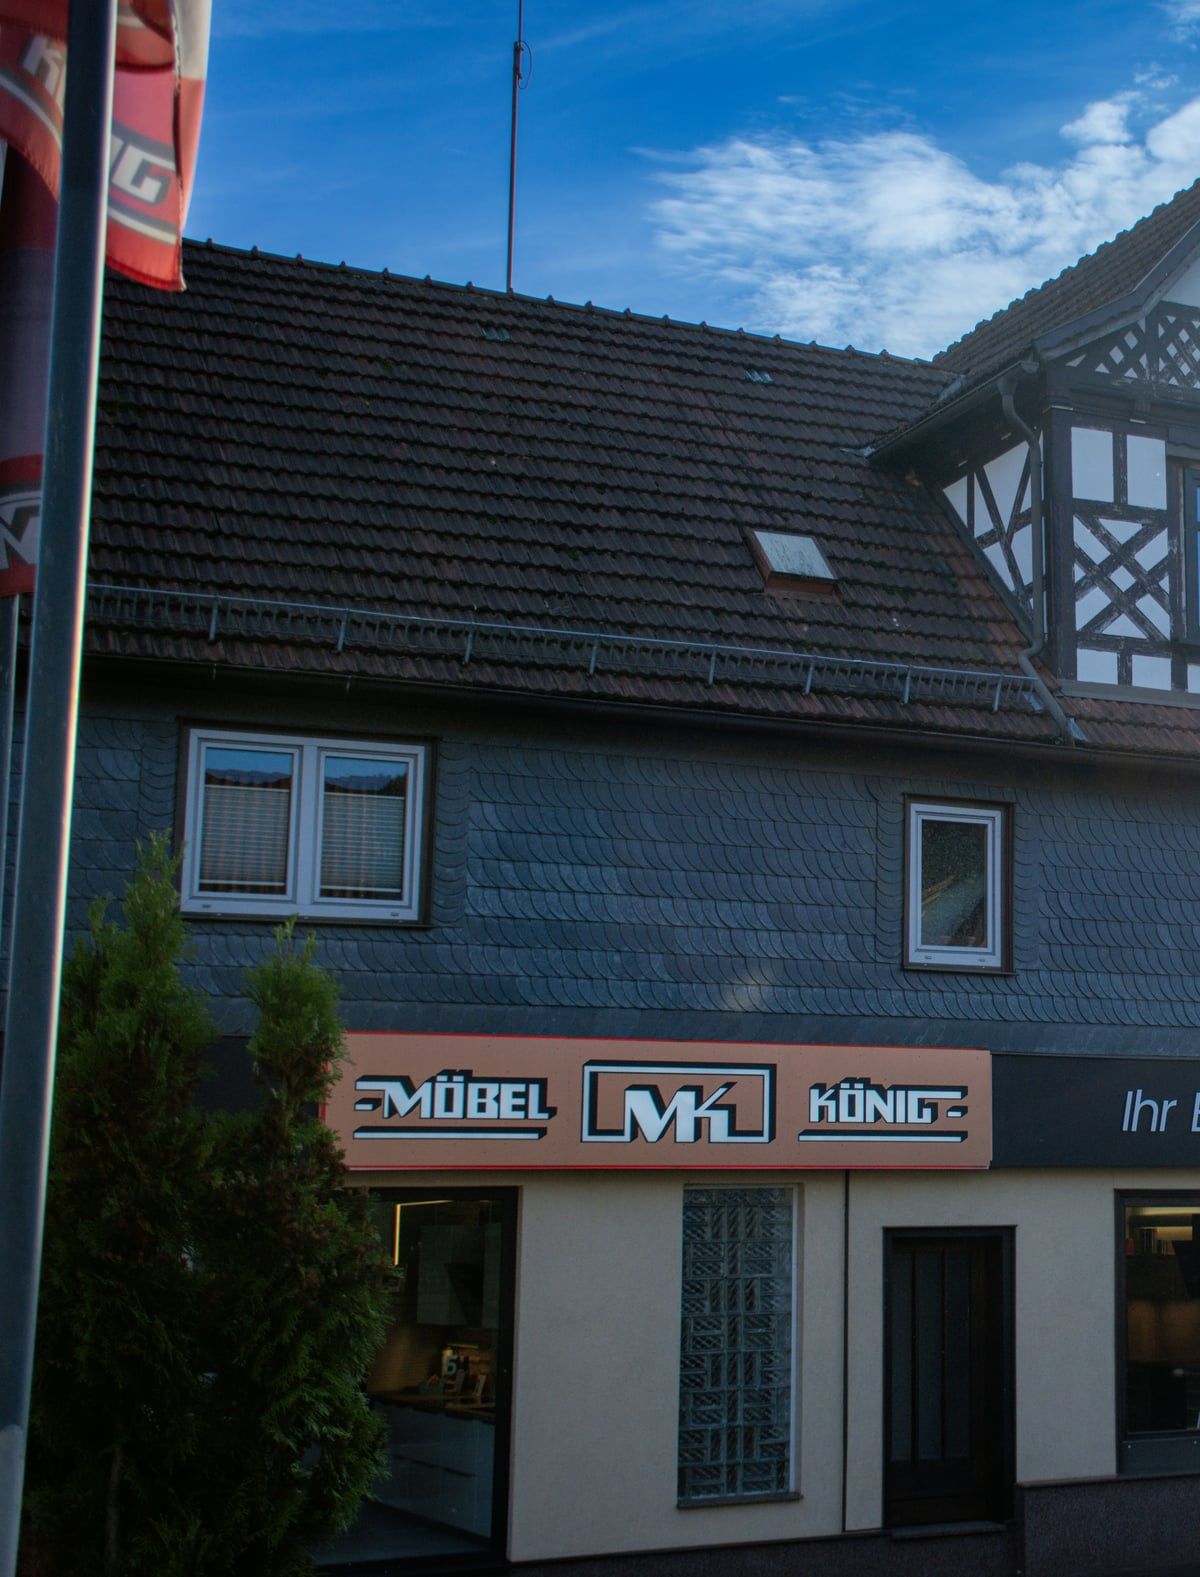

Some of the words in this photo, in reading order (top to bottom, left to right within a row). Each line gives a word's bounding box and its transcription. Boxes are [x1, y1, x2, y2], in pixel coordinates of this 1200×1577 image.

[355, 1069, 557, 1120] MÖBEL
[808, 1077, 968, 1124] KÖNIG
[1122, 1089, 1177, 1132] Ihr
